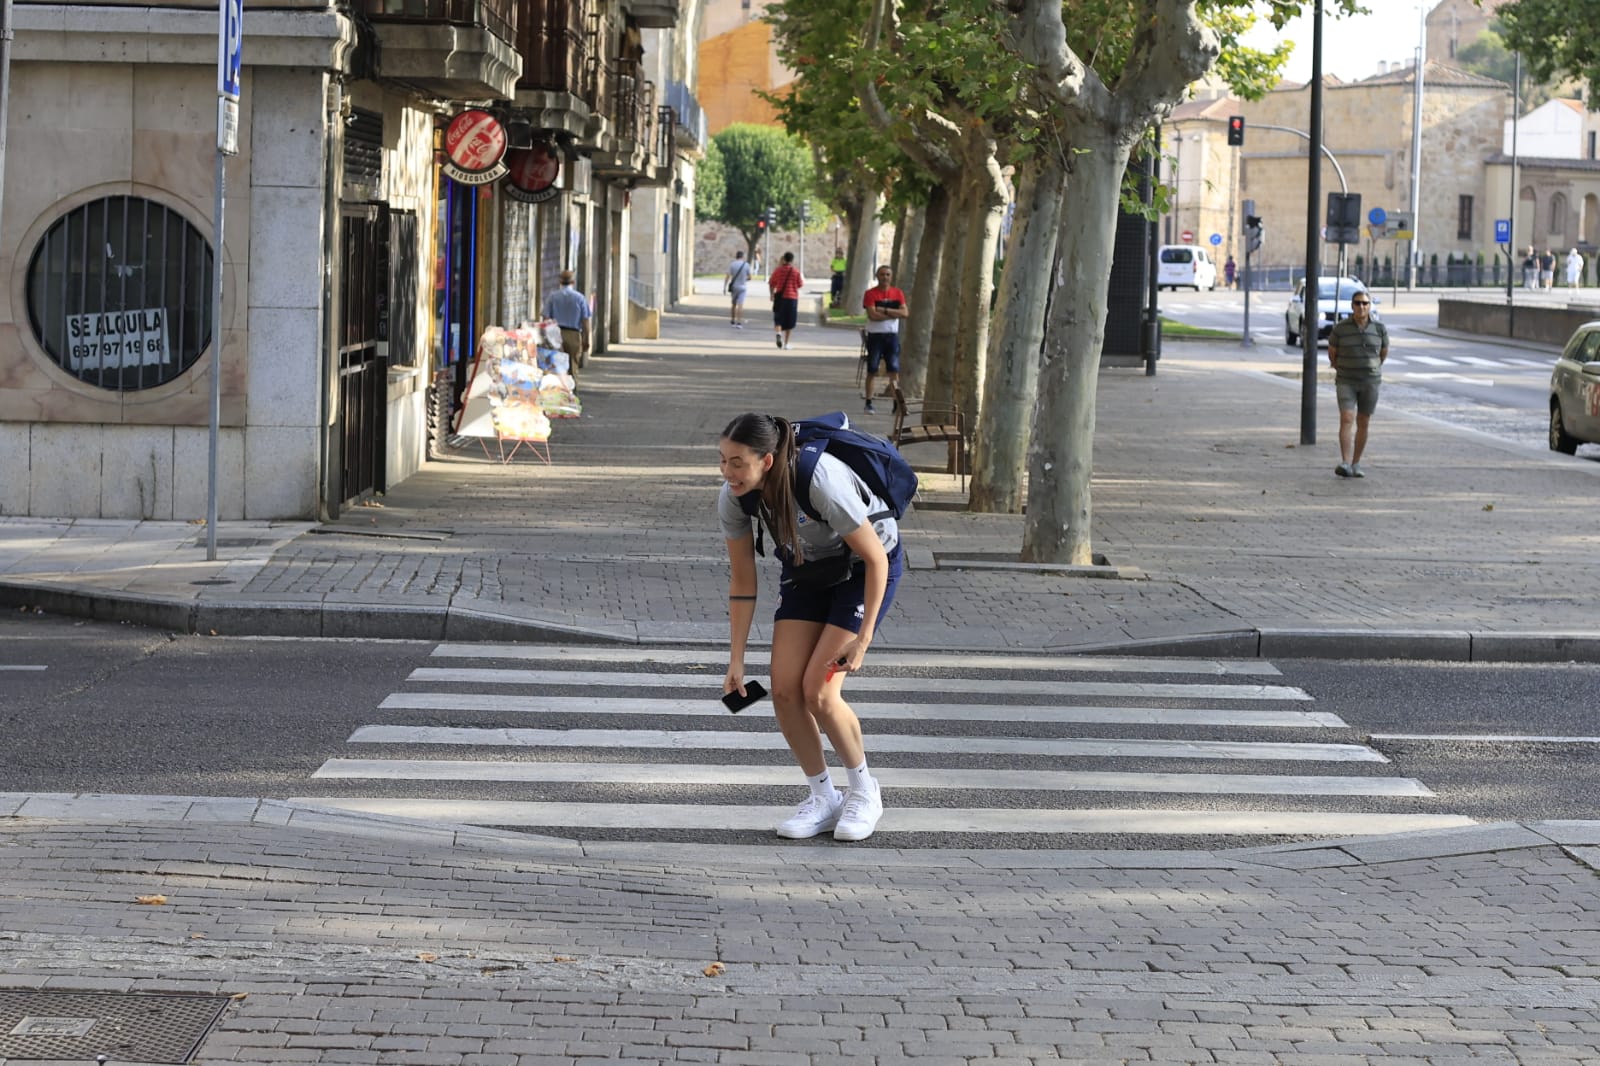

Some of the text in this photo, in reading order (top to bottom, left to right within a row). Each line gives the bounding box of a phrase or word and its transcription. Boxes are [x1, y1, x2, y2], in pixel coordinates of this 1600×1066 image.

[71, 312, 162, 337] SE ALQUILA
[73, 344, 97, 358] 697
[103, 342, 120, 356] 97
[125, 340, 141, 354] 19
